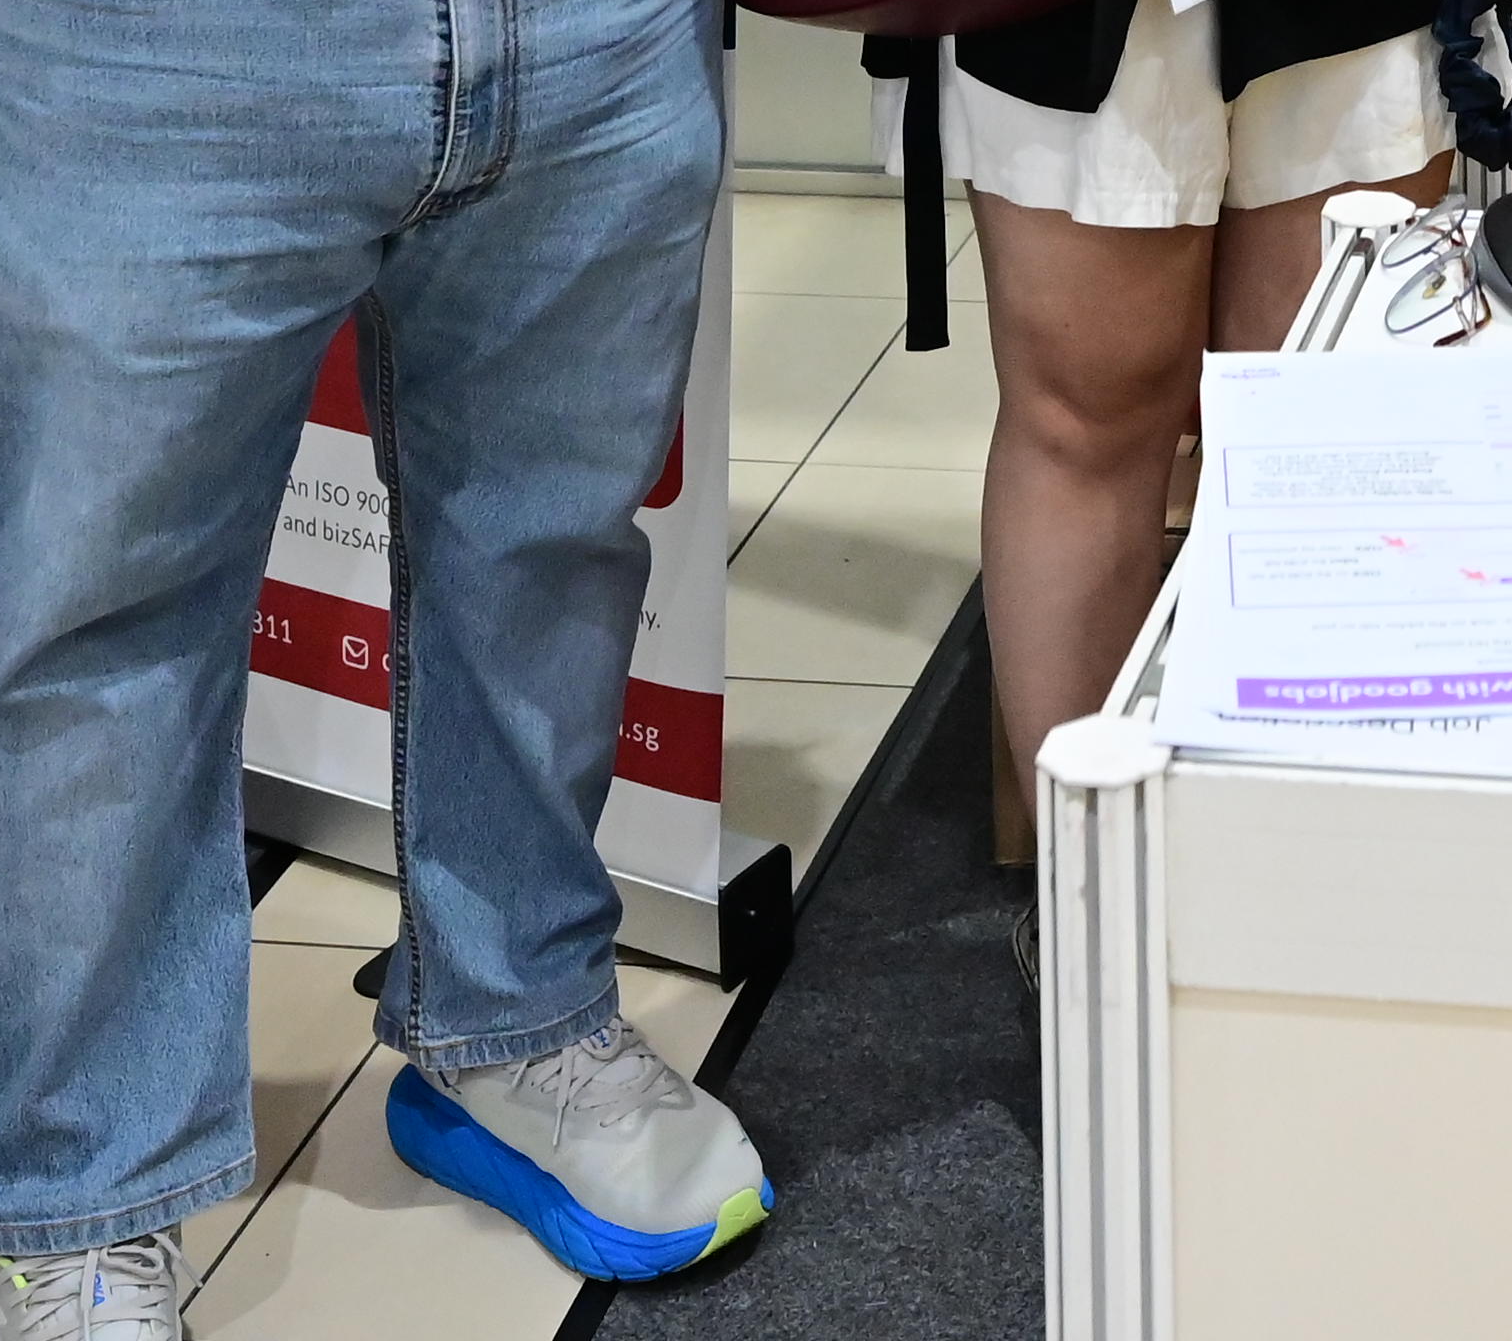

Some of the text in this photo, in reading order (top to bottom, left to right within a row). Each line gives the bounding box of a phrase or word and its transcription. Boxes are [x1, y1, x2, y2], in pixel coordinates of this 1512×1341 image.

[315, 482, 351, 508] ISO
[283, 513, 317, 539] and
[1265, 679, 1432, 706] goodjobs
